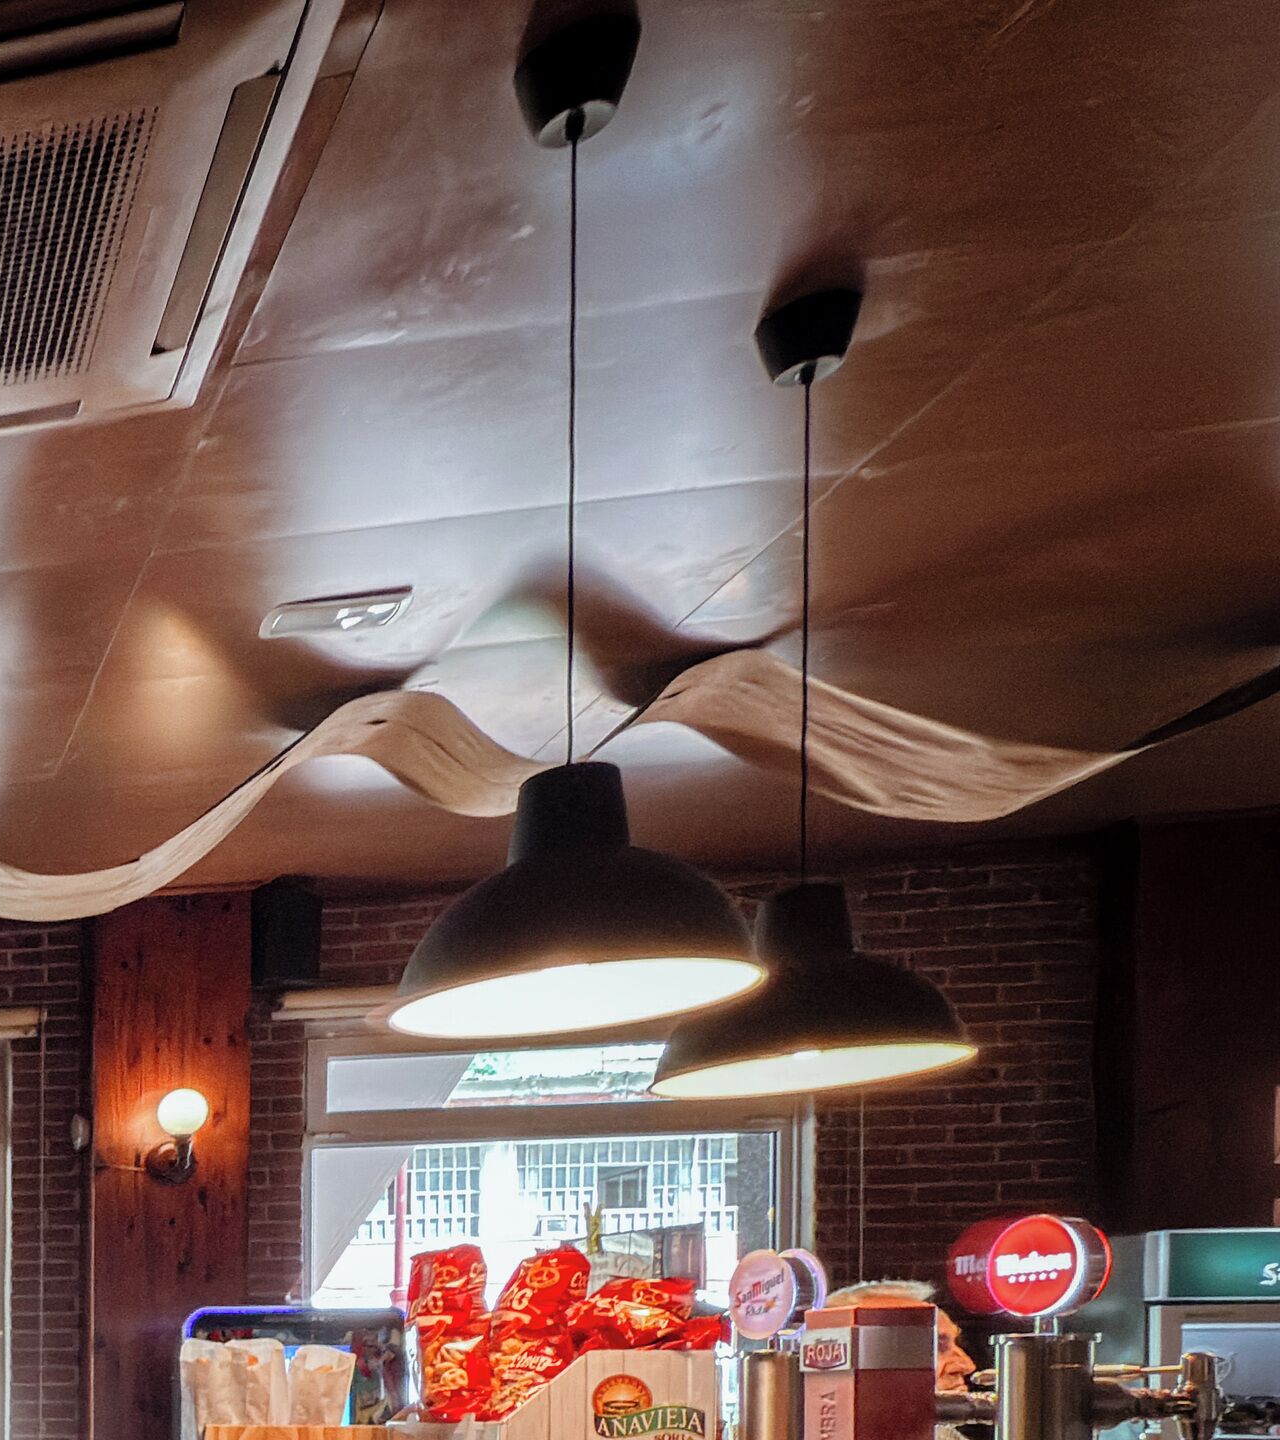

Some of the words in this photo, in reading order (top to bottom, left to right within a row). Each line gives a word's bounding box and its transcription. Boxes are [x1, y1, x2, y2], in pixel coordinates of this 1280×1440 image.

[1259, 1262, 1280, 1287] S
[806, 1343, 842, 1362] ROJA
[597, 1407, 704, 1438] AÑAVIEJA
